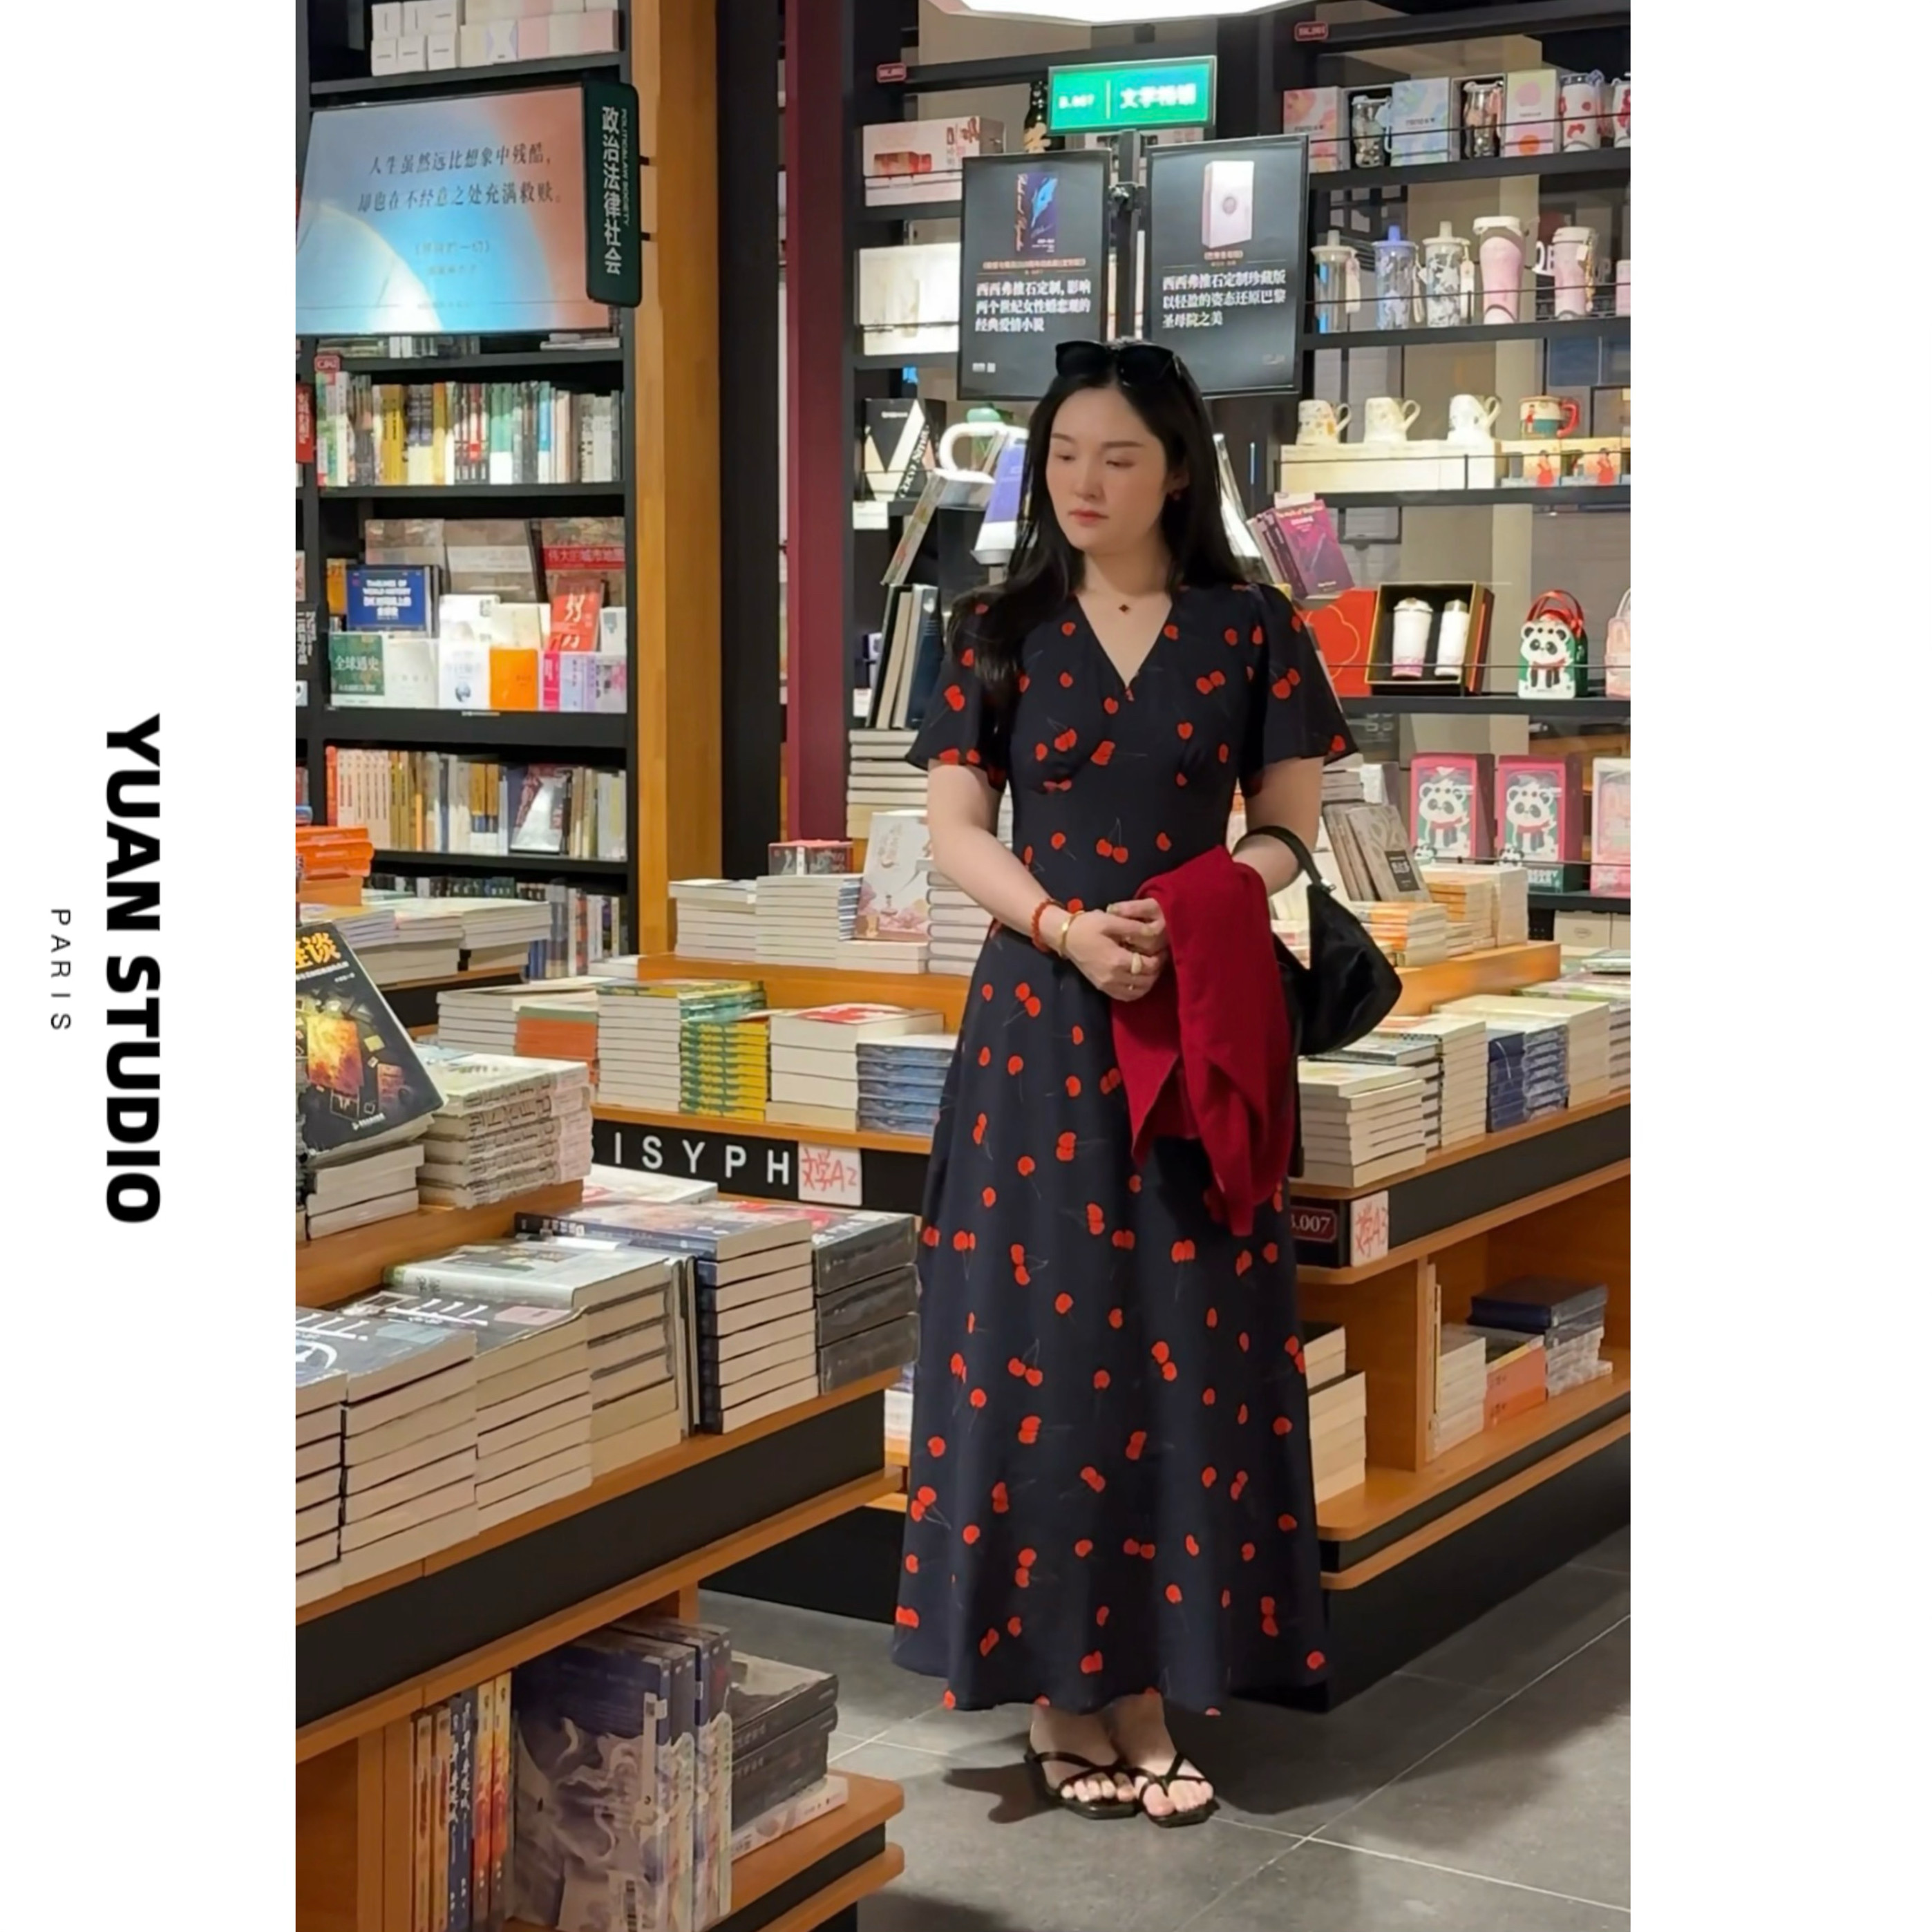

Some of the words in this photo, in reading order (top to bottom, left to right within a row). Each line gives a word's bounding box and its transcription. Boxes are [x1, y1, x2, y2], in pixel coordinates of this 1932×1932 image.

[1119, 84, 1197, 110] 文学
[603, 106, 622, 275] 政治法律社会
[334, 656, 379, 672] 全球通史
[590, 1131, 790, 1186] ISYPH
